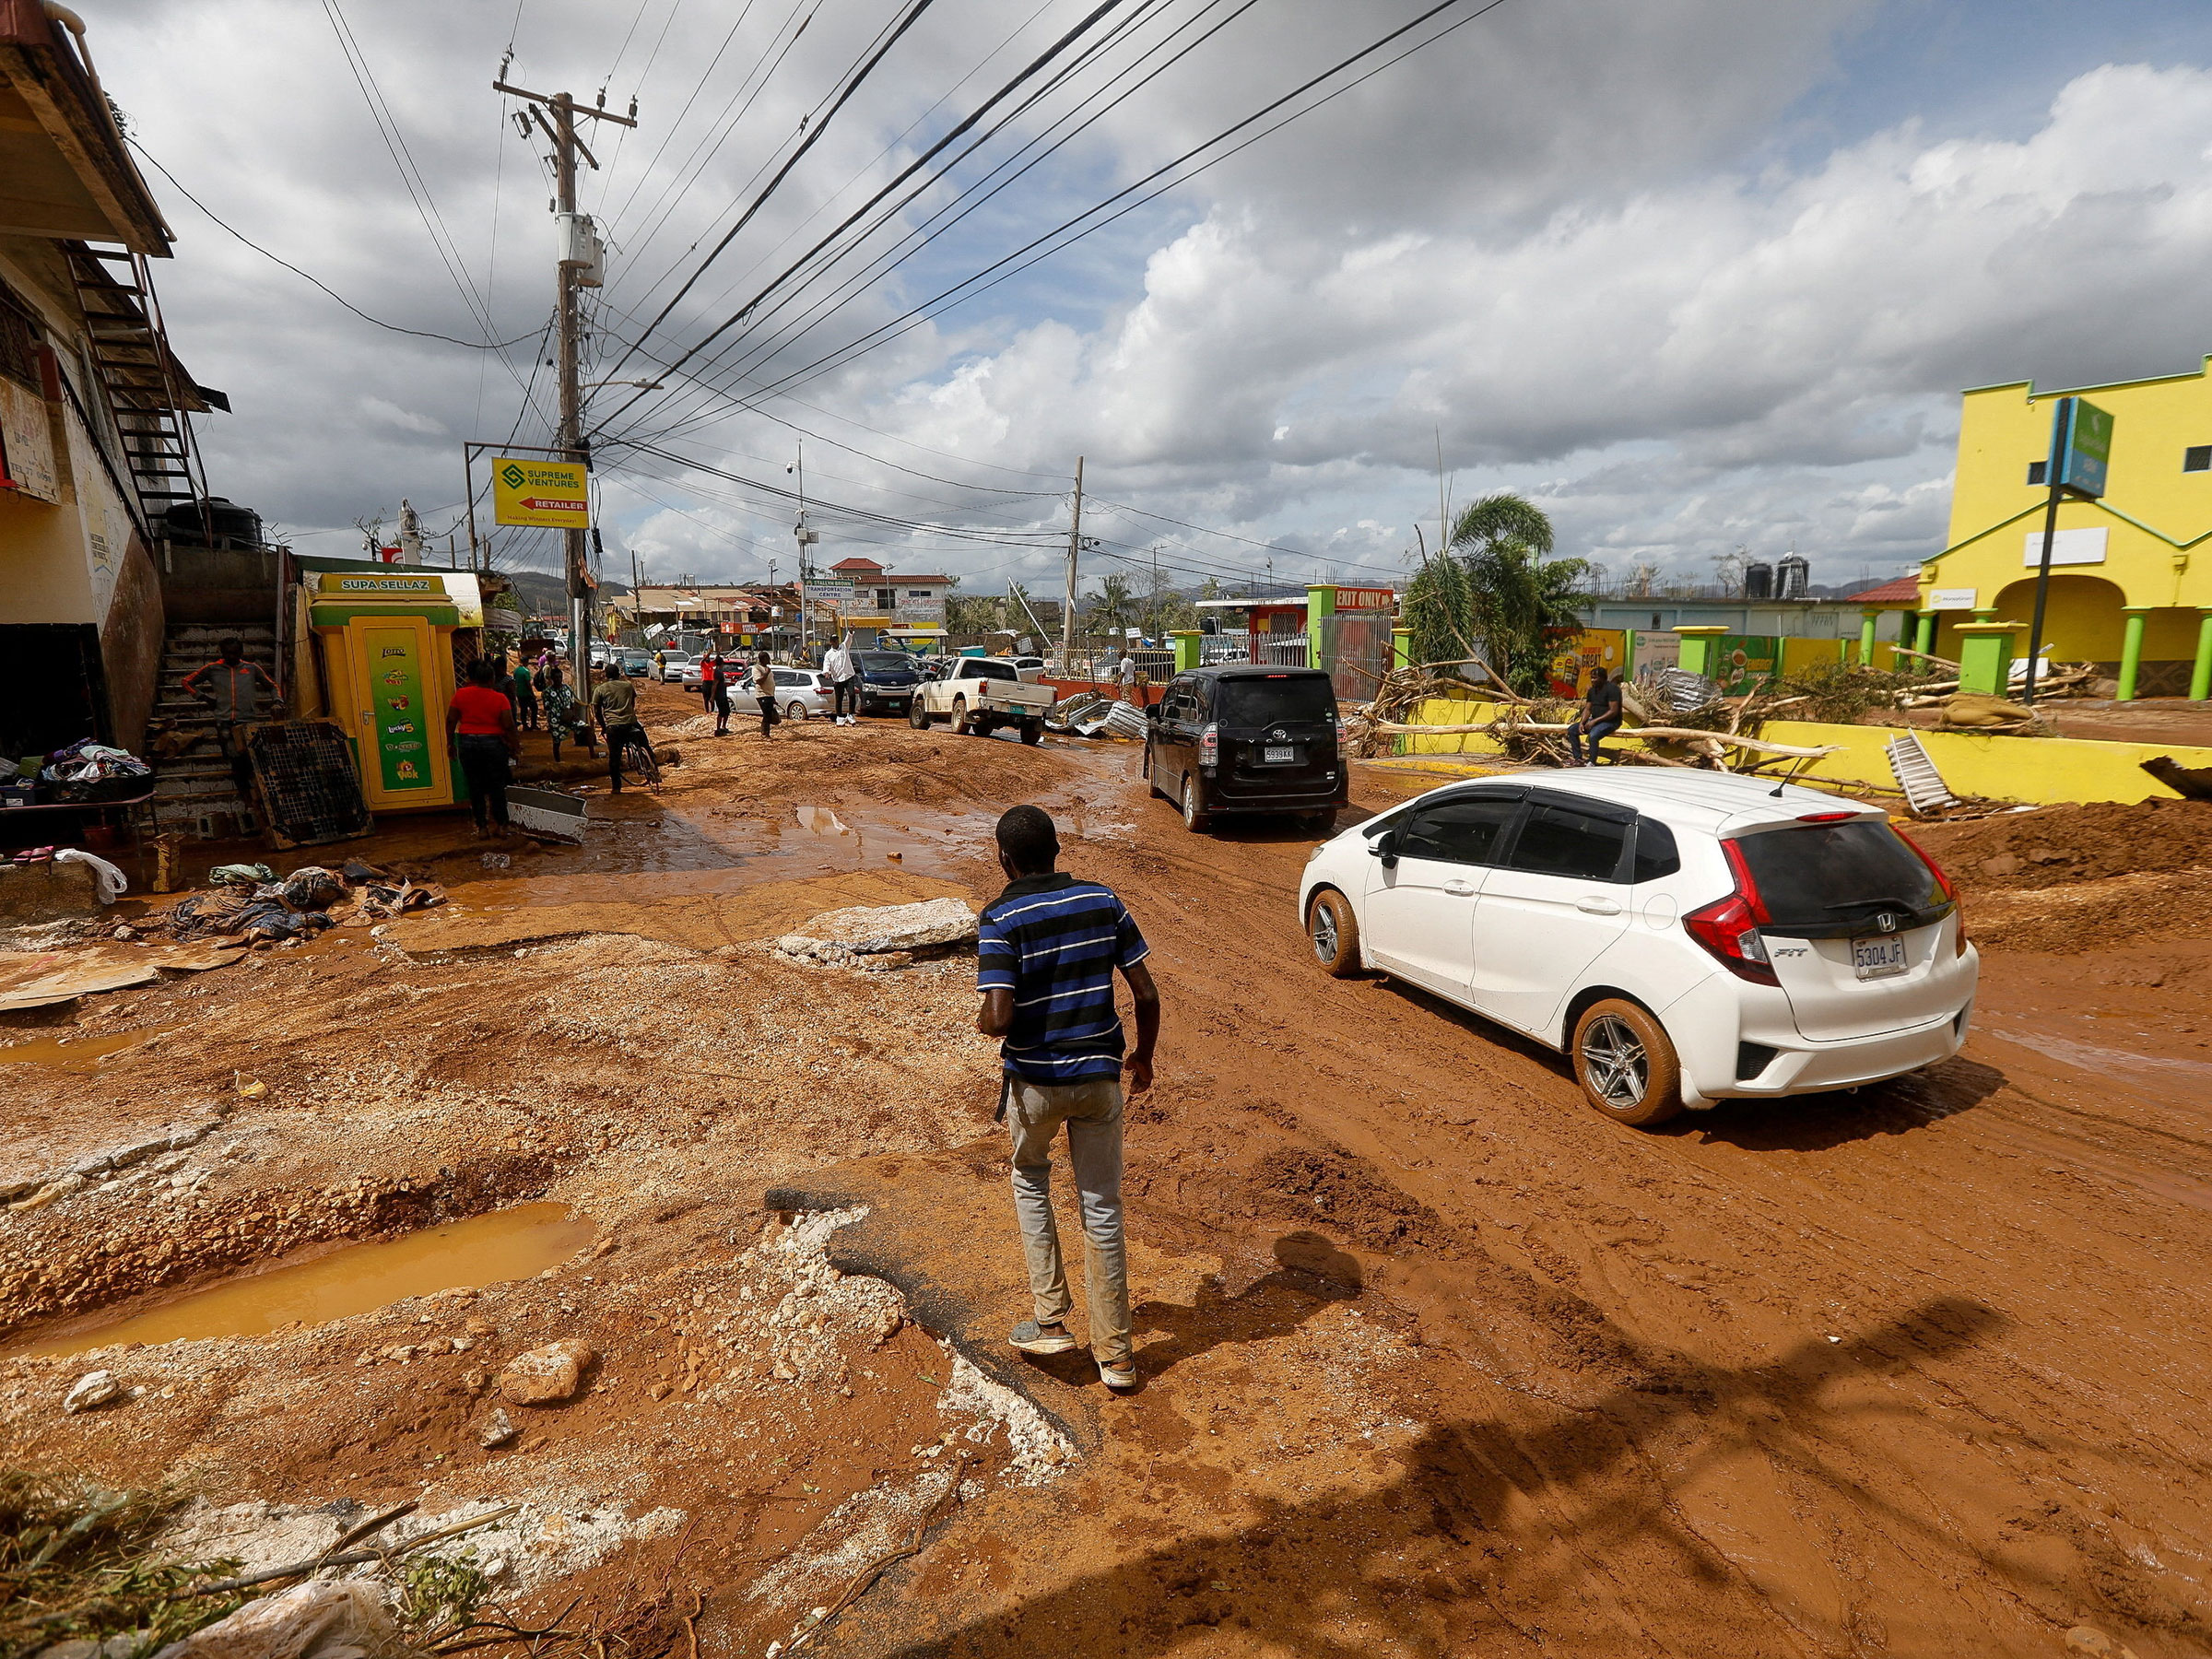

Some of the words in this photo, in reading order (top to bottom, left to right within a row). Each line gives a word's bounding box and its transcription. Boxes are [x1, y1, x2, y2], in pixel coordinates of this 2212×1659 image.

[527, 470, 574, 480] SUPREME
[527, 478, 580, 488] VENTURES
[535, 500, 584, 510] RETAILER
[341, 580, 378, 590] SUPA
[380, 580, 429, 590] SELLAZ
[1336, 591, 1357, 606] EXIT
[1359, 591, 1382, 608] ONLY
[1774, 947, 1808, 959] FIT
[1856, 946, 1887, 968] 5304
[1889, 944, 1900, 963] JF
